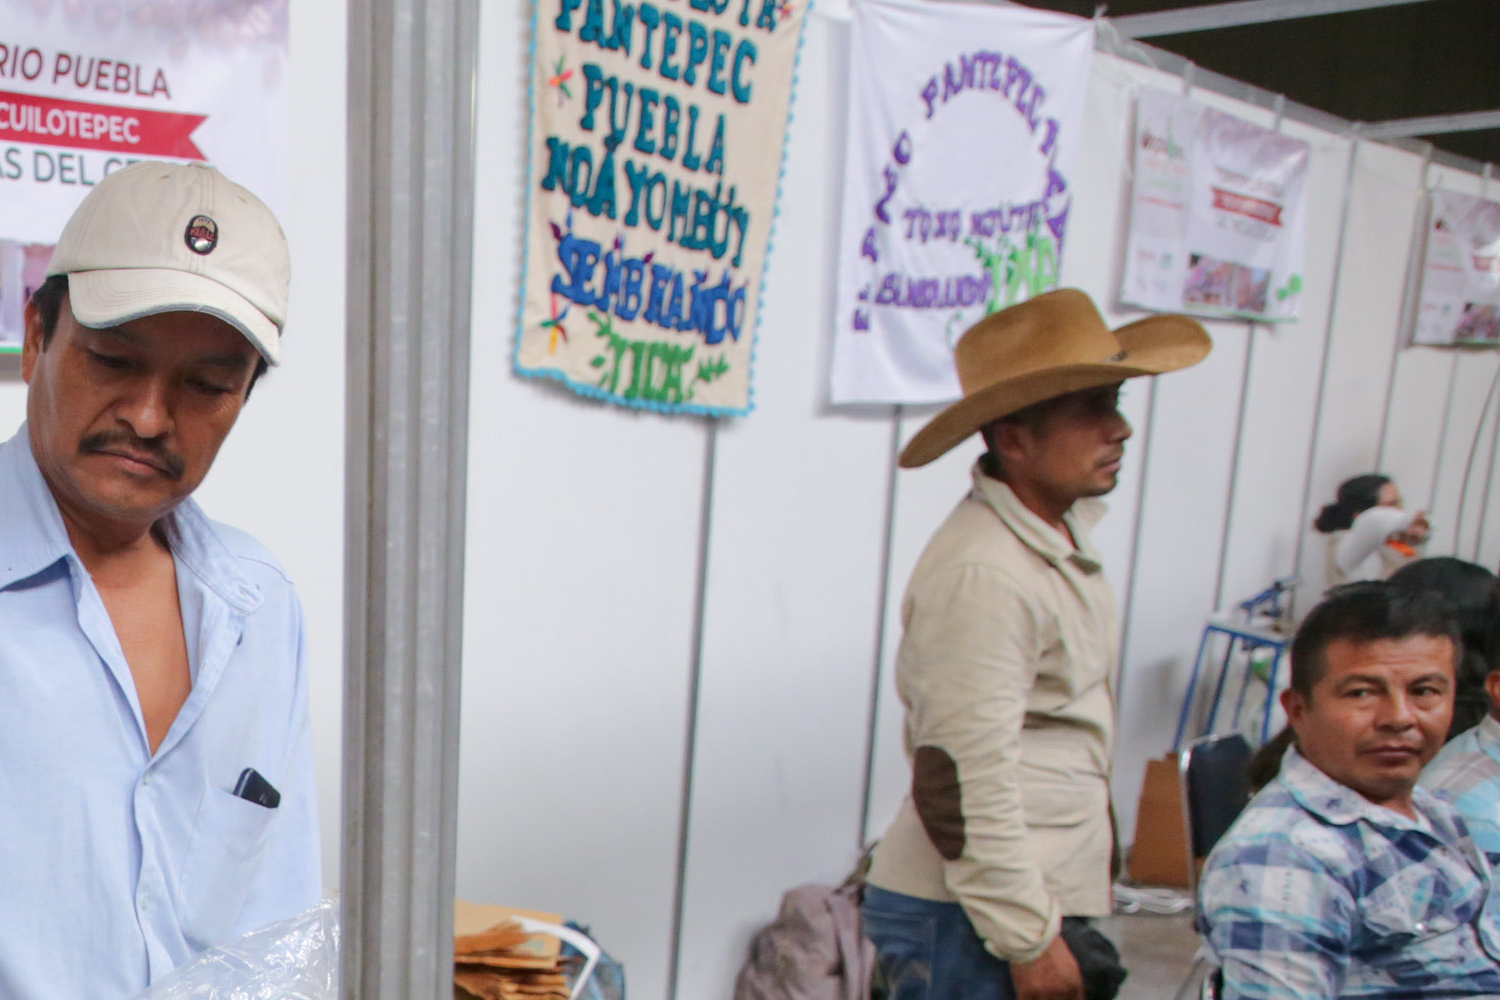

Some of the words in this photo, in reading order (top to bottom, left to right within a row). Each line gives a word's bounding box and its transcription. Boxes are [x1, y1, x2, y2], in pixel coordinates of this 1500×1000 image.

[53, 53, 172, 99] PUEBLA
[555, 0, 757, 104] PANTEPEC
[580, 64, 727, 175] PUEBLA
[33, 150, 95, 185] DEL
